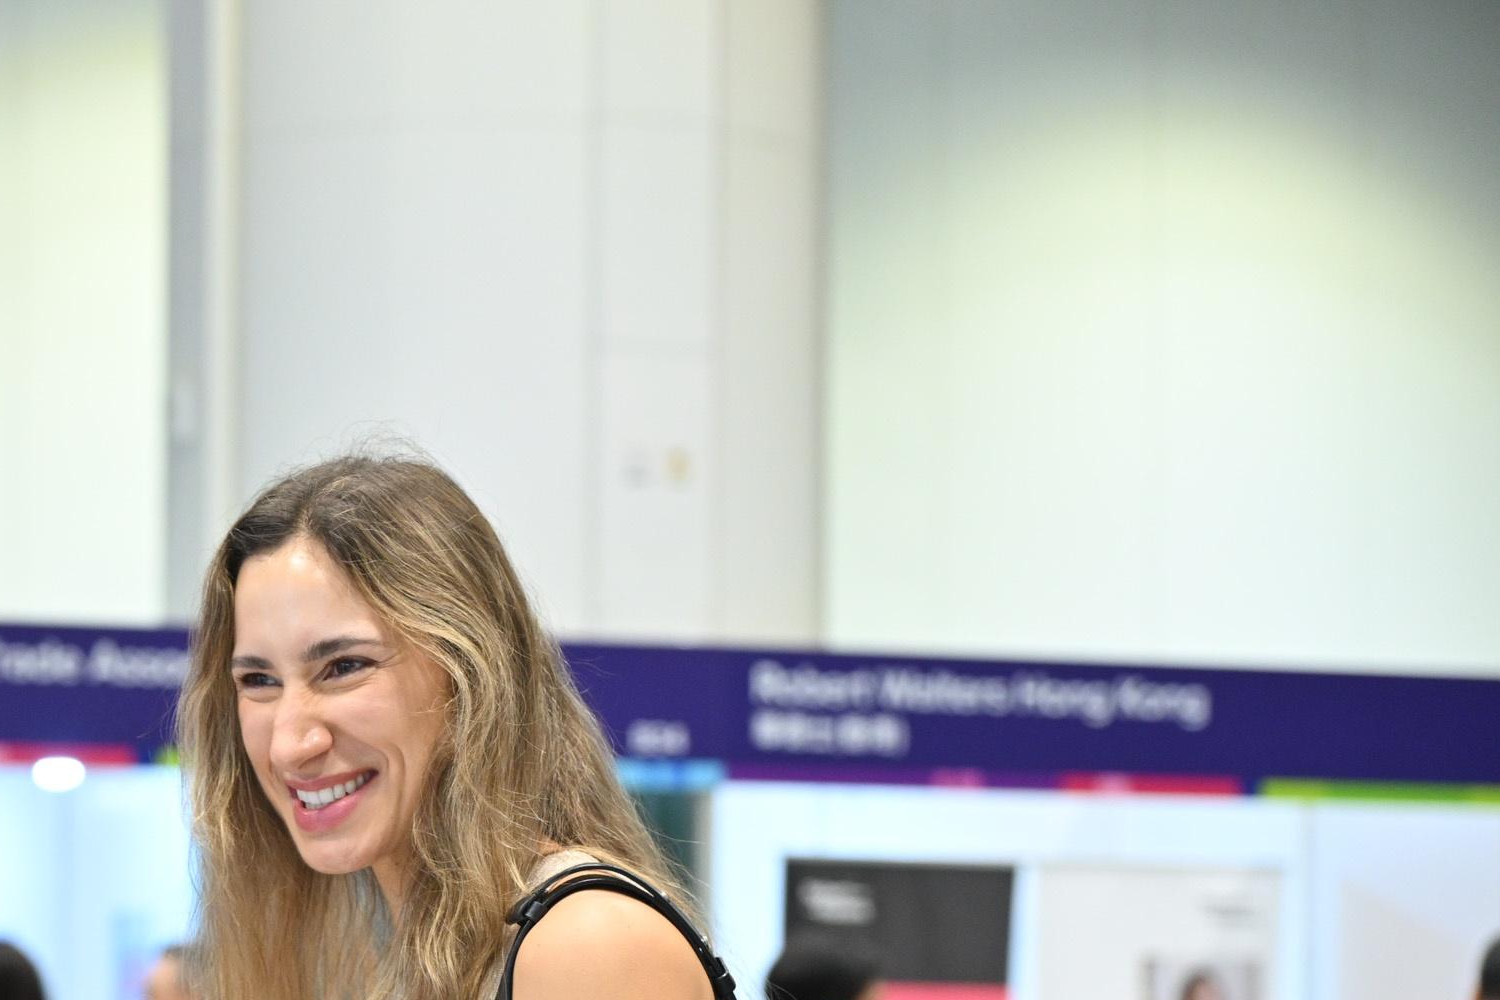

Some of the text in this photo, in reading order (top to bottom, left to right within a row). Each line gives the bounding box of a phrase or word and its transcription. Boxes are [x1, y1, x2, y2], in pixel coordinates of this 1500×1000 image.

[750, 661, 1211, 730] Robert Walters Hong Kong
